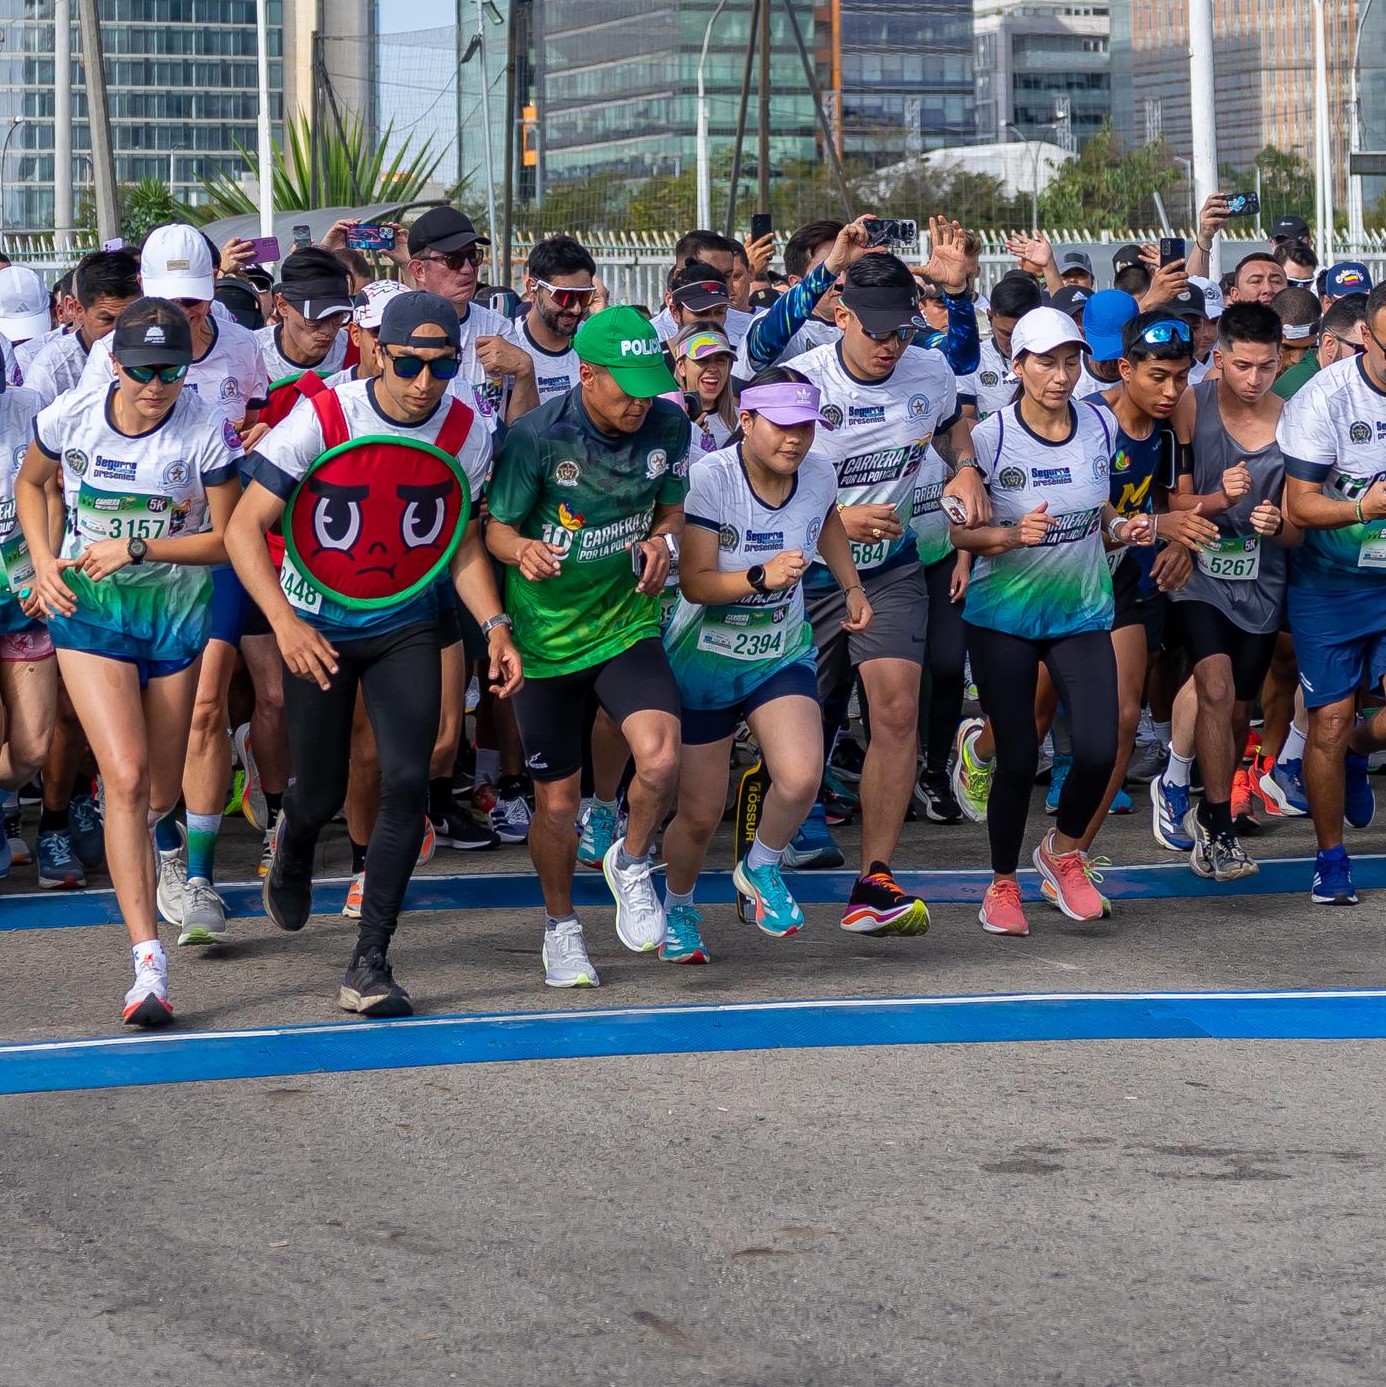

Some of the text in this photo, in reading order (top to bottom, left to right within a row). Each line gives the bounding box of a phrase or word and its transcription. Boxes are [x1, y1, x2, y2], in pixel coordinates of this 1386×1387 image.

[845, 449, 903, 475] CARRERA
[840, 474, 856, 485] POR
[857, 473, 868, 483] LA
[149, 500, 165, 511] 5K
[109, 518, 165, 539] 3157
[583, 514, 641, 548] CARRERA
[579, 546, 609, 561] POR LA
[1244, 539, 1257, 551] 5K
[1210, 557, 1256, 577] 5267
[733, 631, 782, 655] 2394
[745, 794, 761, 844] ÖSSUR
